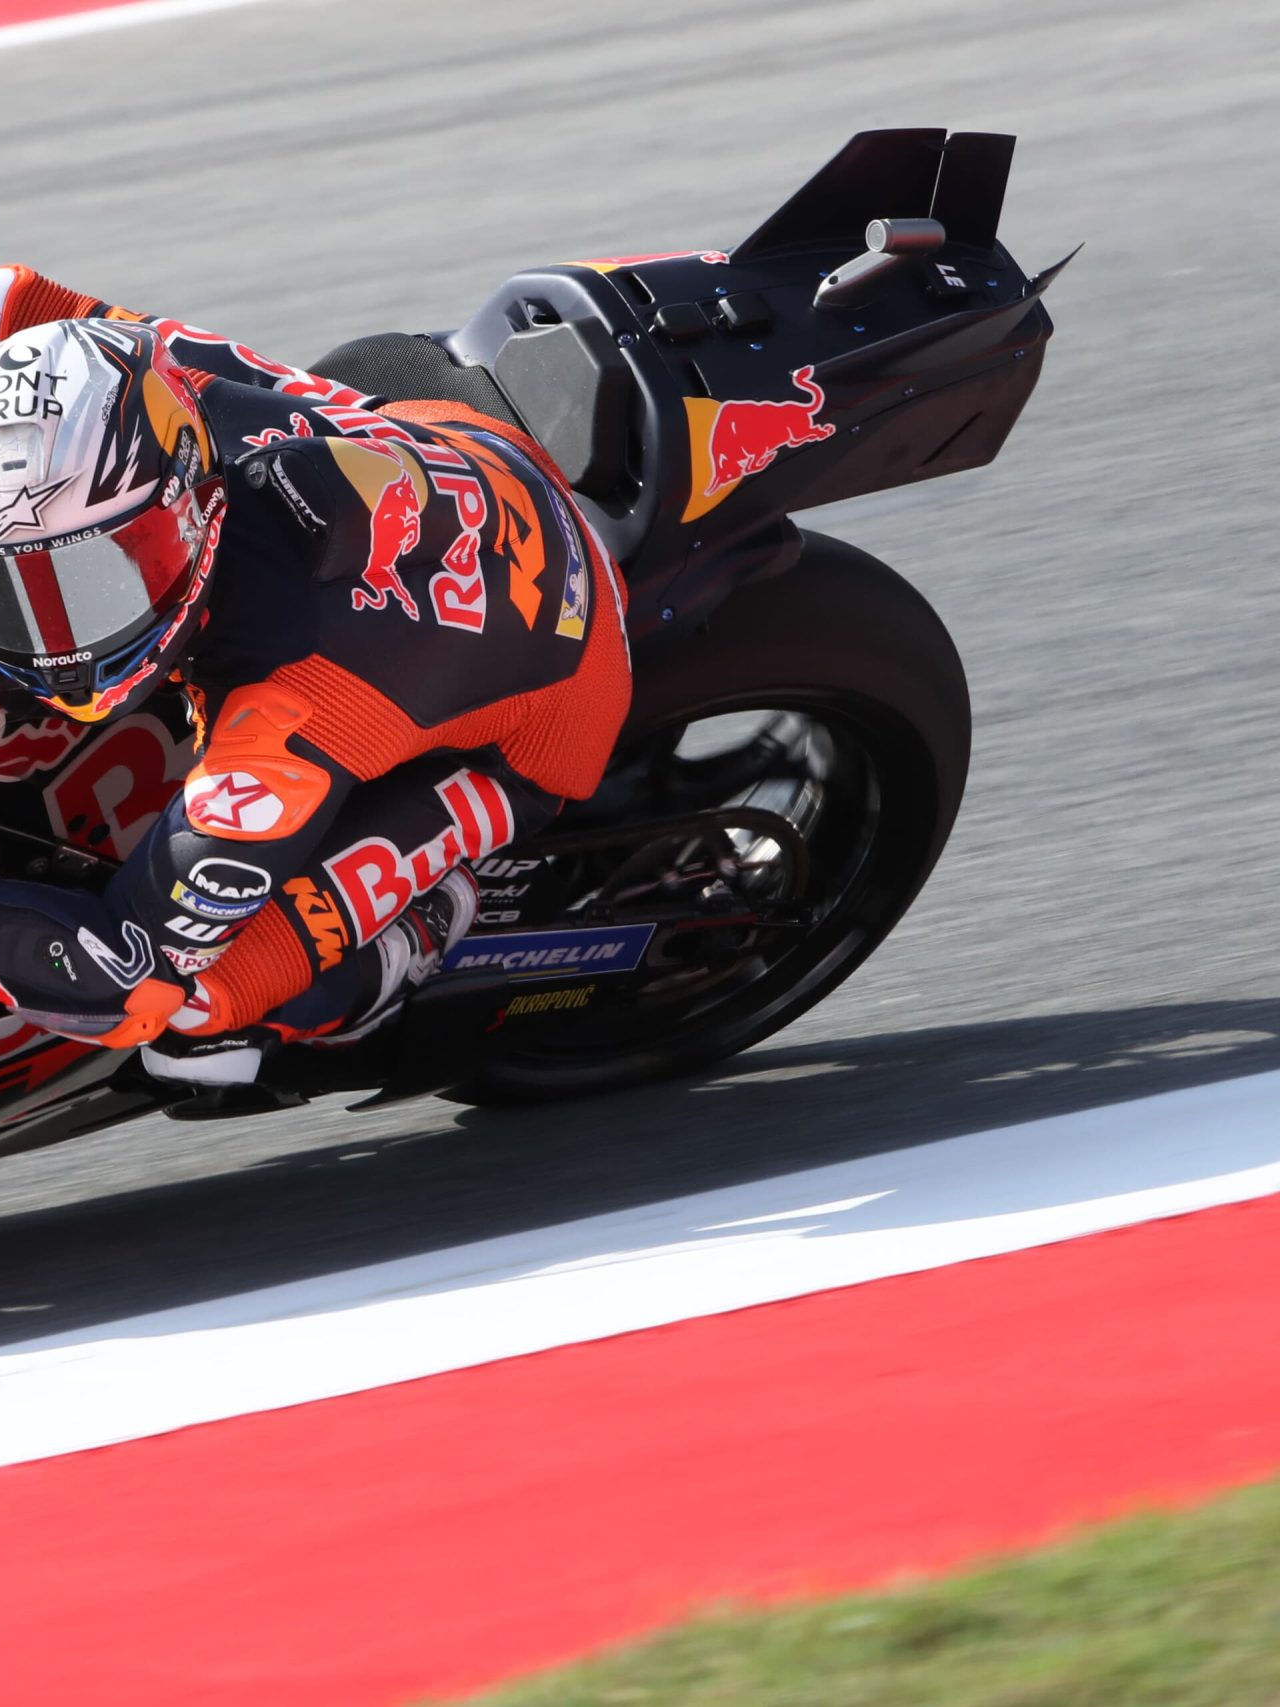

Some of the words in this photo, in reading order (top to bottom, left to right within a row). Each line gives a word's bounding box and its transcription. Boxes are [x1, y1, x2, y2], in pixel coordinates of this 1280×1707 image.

[200, 486, 225, 525] CORNY
[14, 542, 43, 555] YOU
[51, 526, 102, 548] WINGS
[428, 471, 489, 635] Red
[32, 651, 93, 668] Norauto
[321, 767, 515, 950] Bull
[195, 873, 266, 899] MAN
[198, 902, 262, 916] MICHELIN
[281, 876, 350, 973] KTM
[456, 943, 625, 970] MICHELIN
